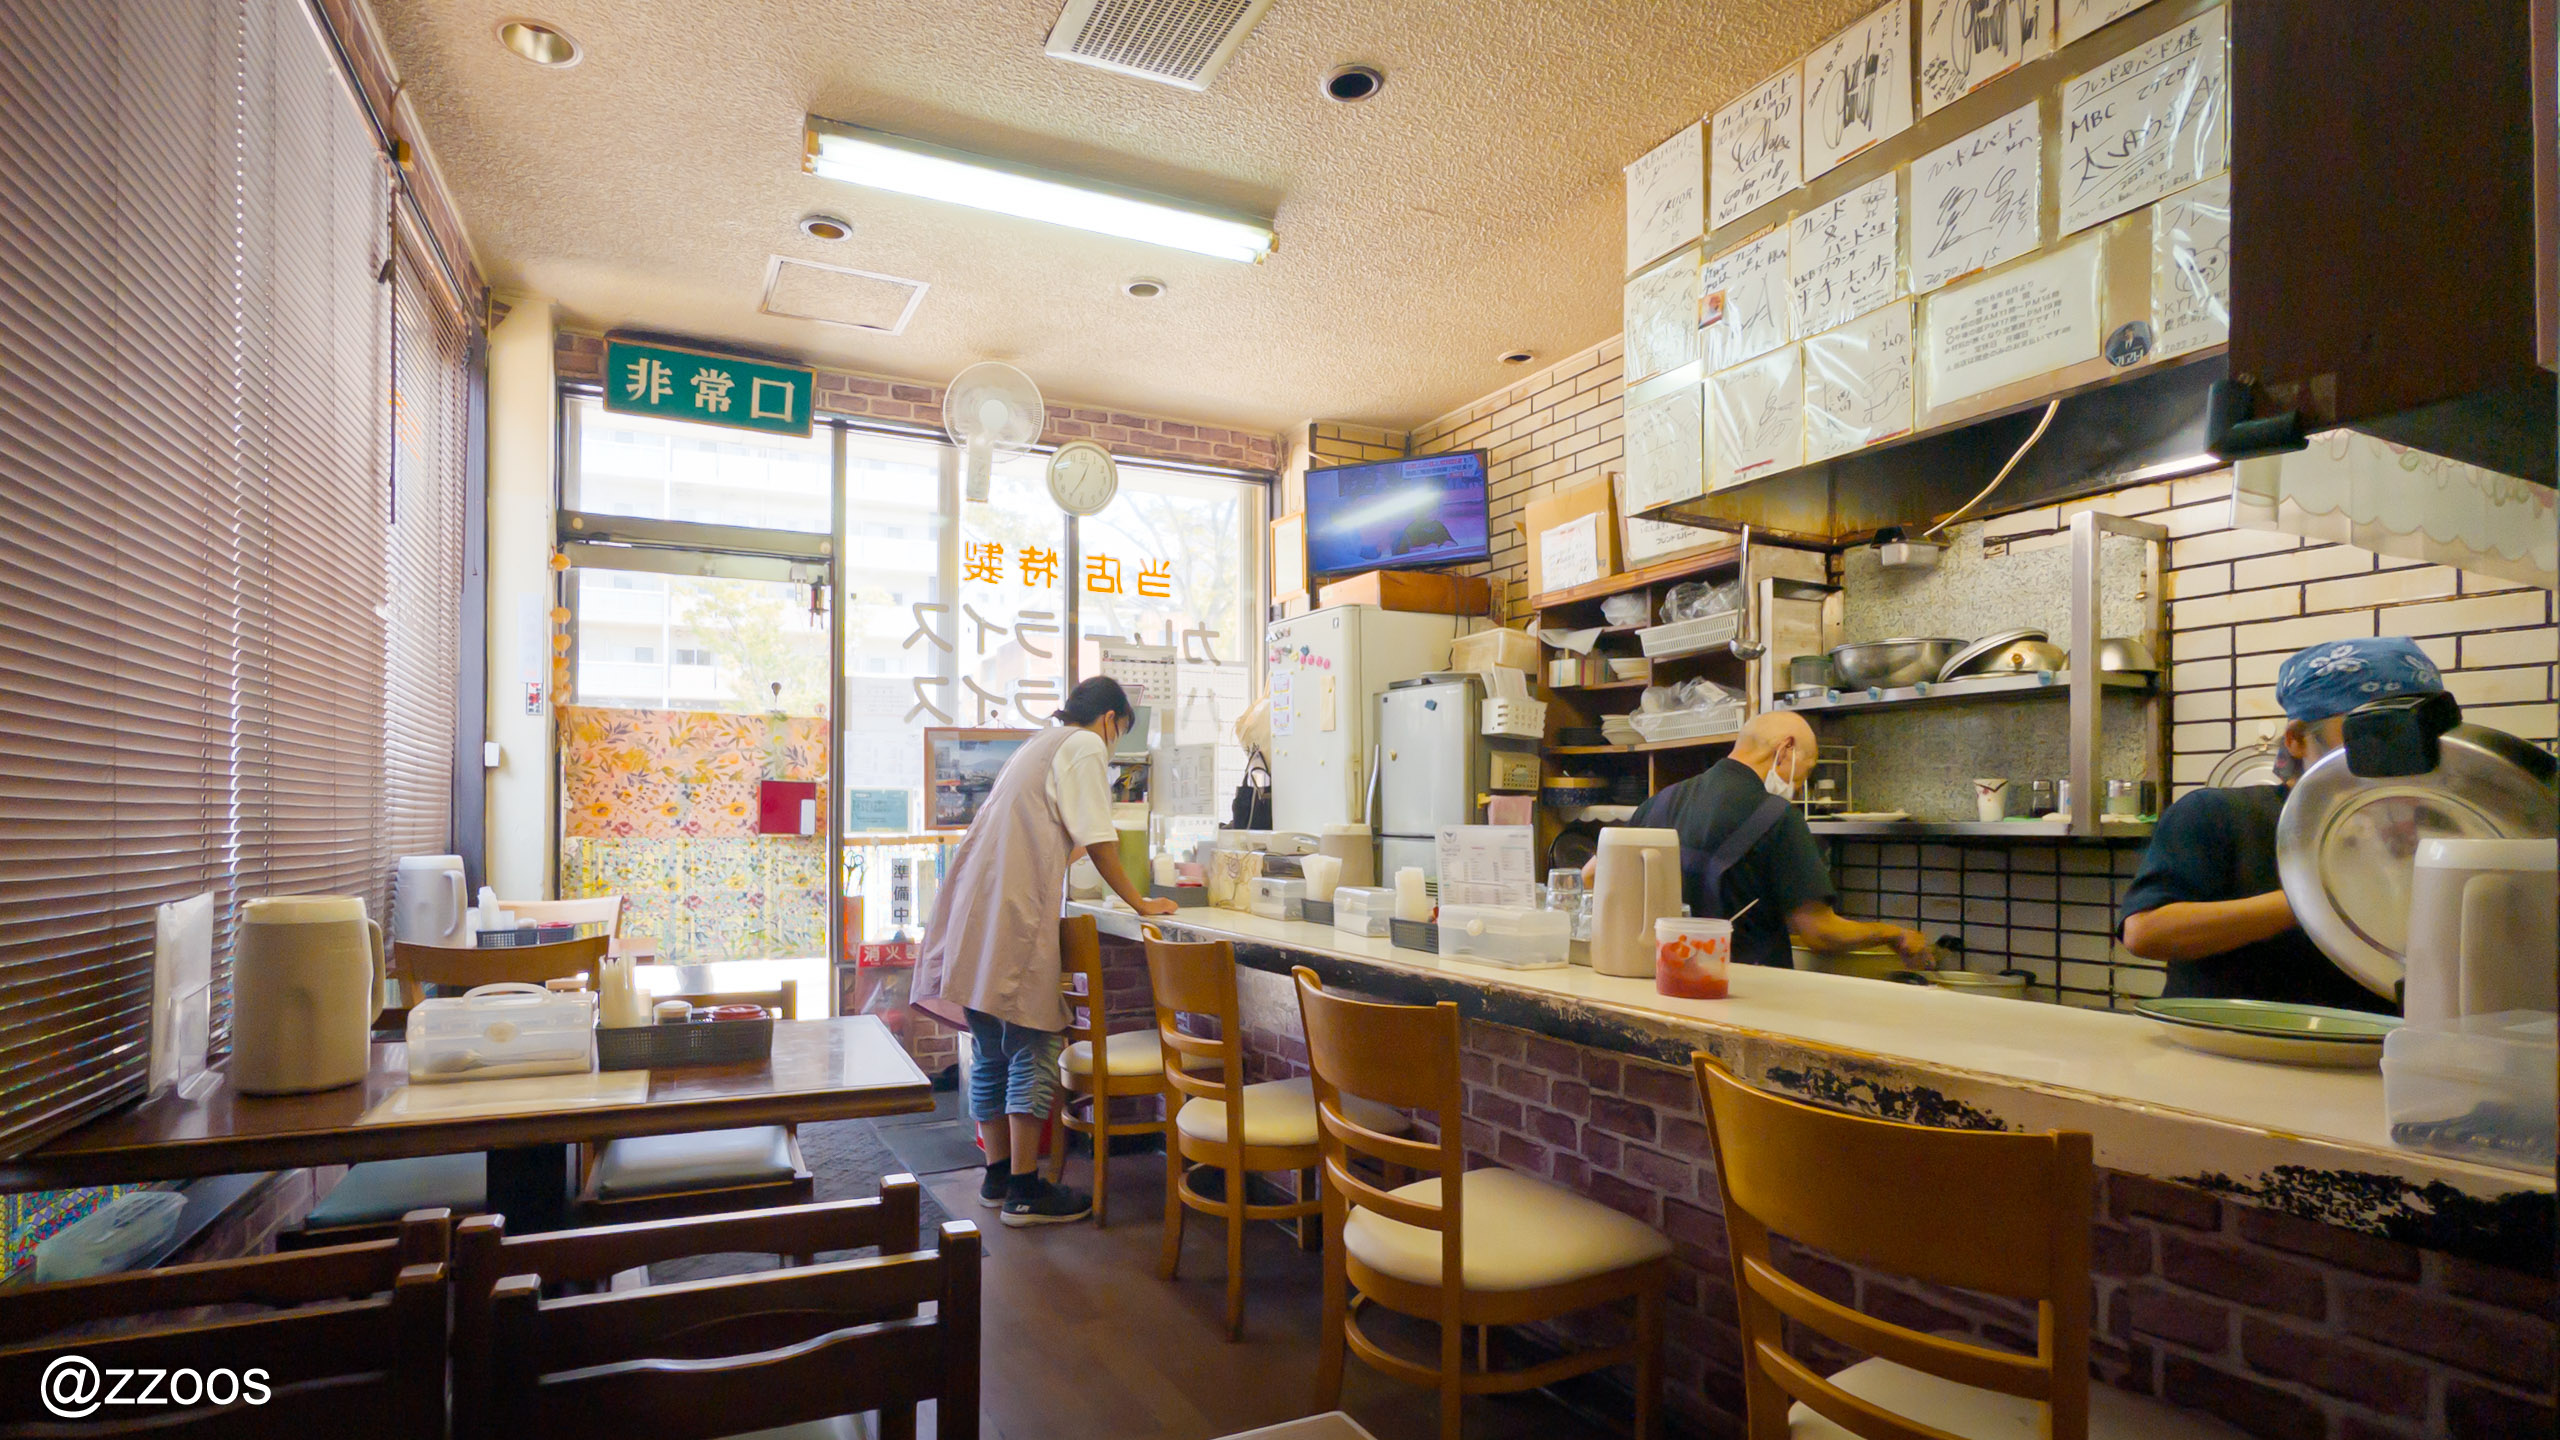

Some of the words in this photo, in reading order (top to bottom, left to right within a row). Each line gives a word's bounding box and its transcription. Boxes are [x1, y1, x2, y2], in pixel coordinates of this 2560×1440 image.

[2070, 102, 2117, 144] MBC
[625, 357, 795, 423] 非常口
[893, 863, 910, 924] 準備中
